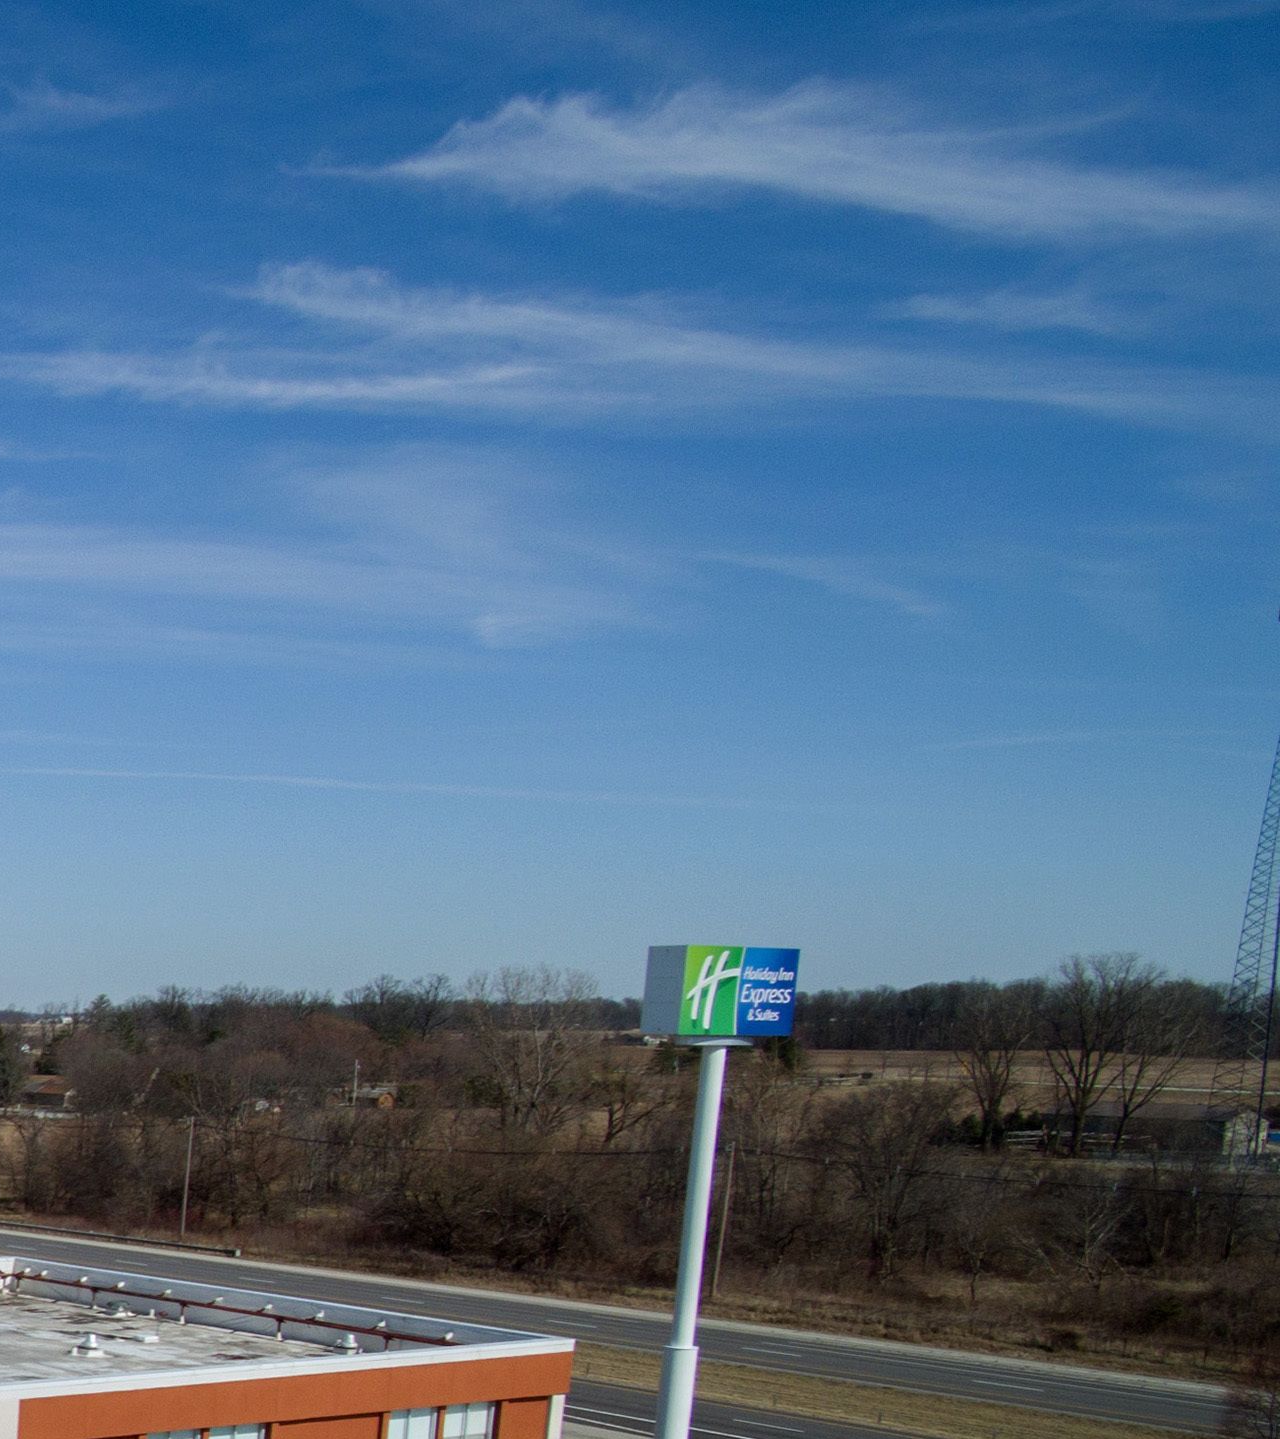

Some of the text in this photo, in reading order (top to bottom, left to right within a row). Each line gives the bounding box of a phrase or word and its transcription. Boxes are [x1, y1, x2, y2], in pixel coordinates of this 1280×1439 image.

[743, 966, 794, 984] Holiday Inn
[741, 984, 792, 1007] Express
[747, 1010, 781, 1021] & Suites
